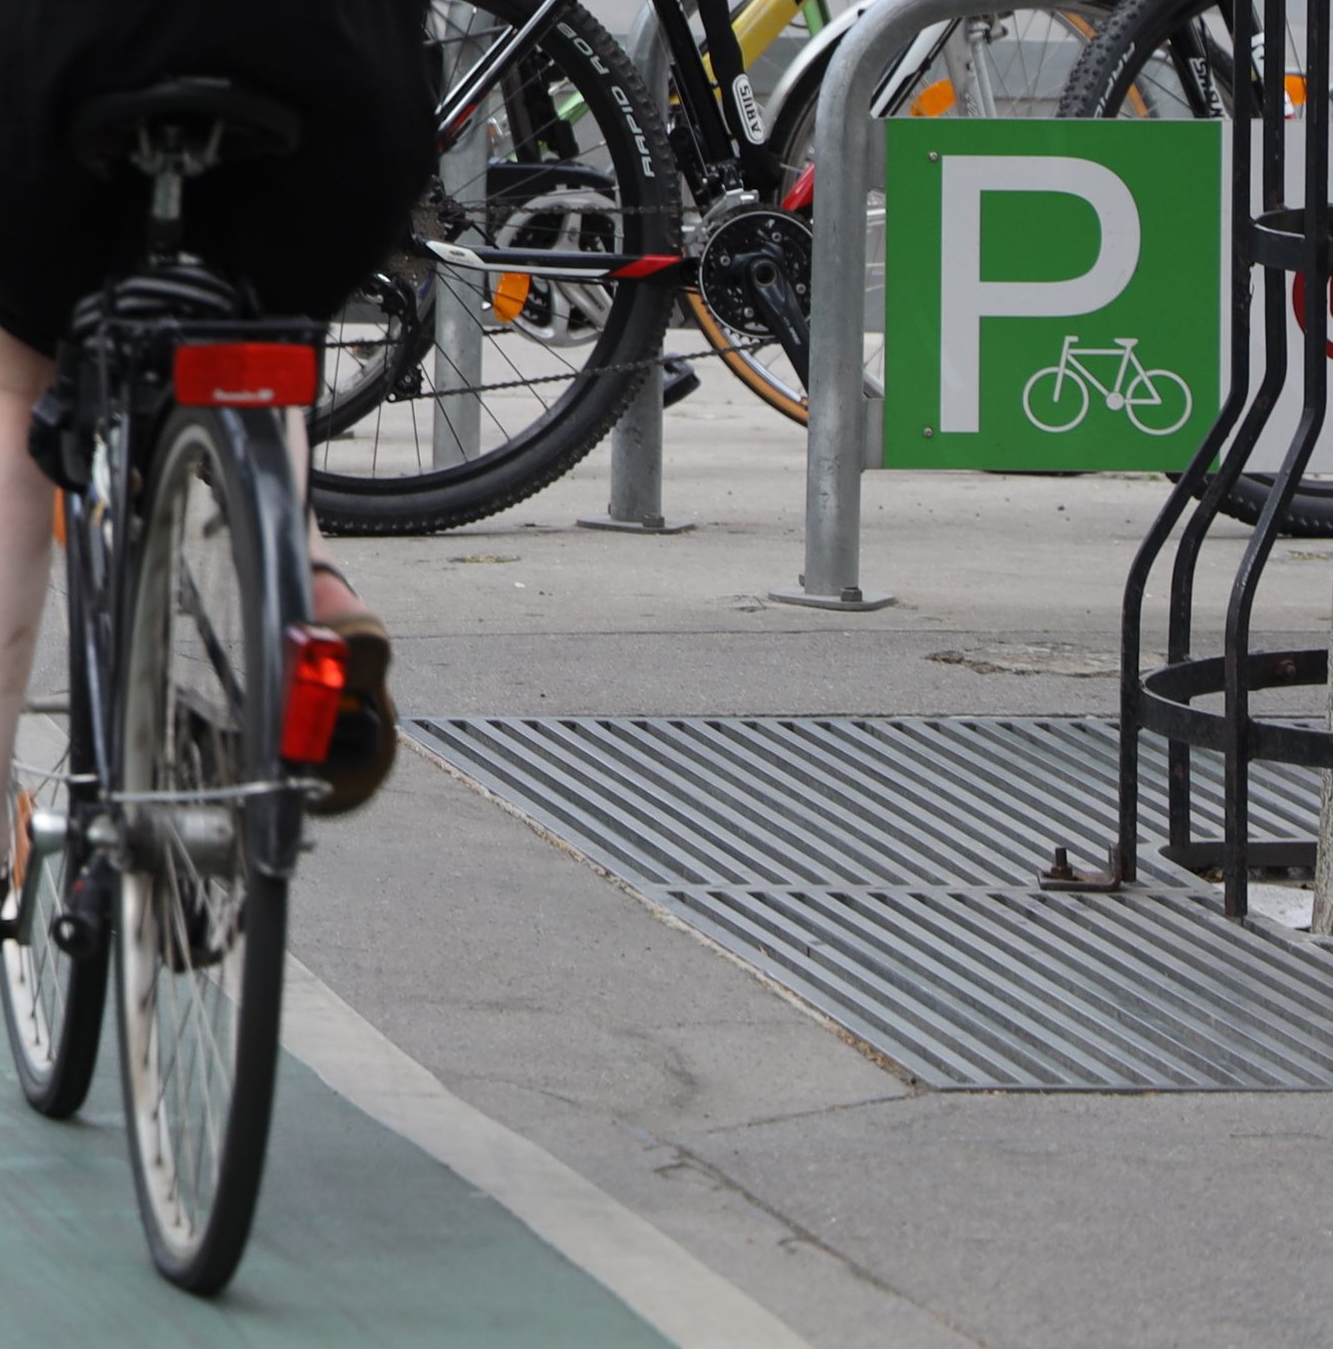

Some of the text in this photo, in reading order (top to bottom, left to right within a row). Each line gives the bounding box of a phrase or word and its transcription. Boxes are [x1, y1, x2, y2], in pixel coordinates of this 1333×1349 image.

[556, 20, 657, 179] RAPID ROB
[739, 83, 763, 134] ABUS
[939, 154, 1141, 433] P
